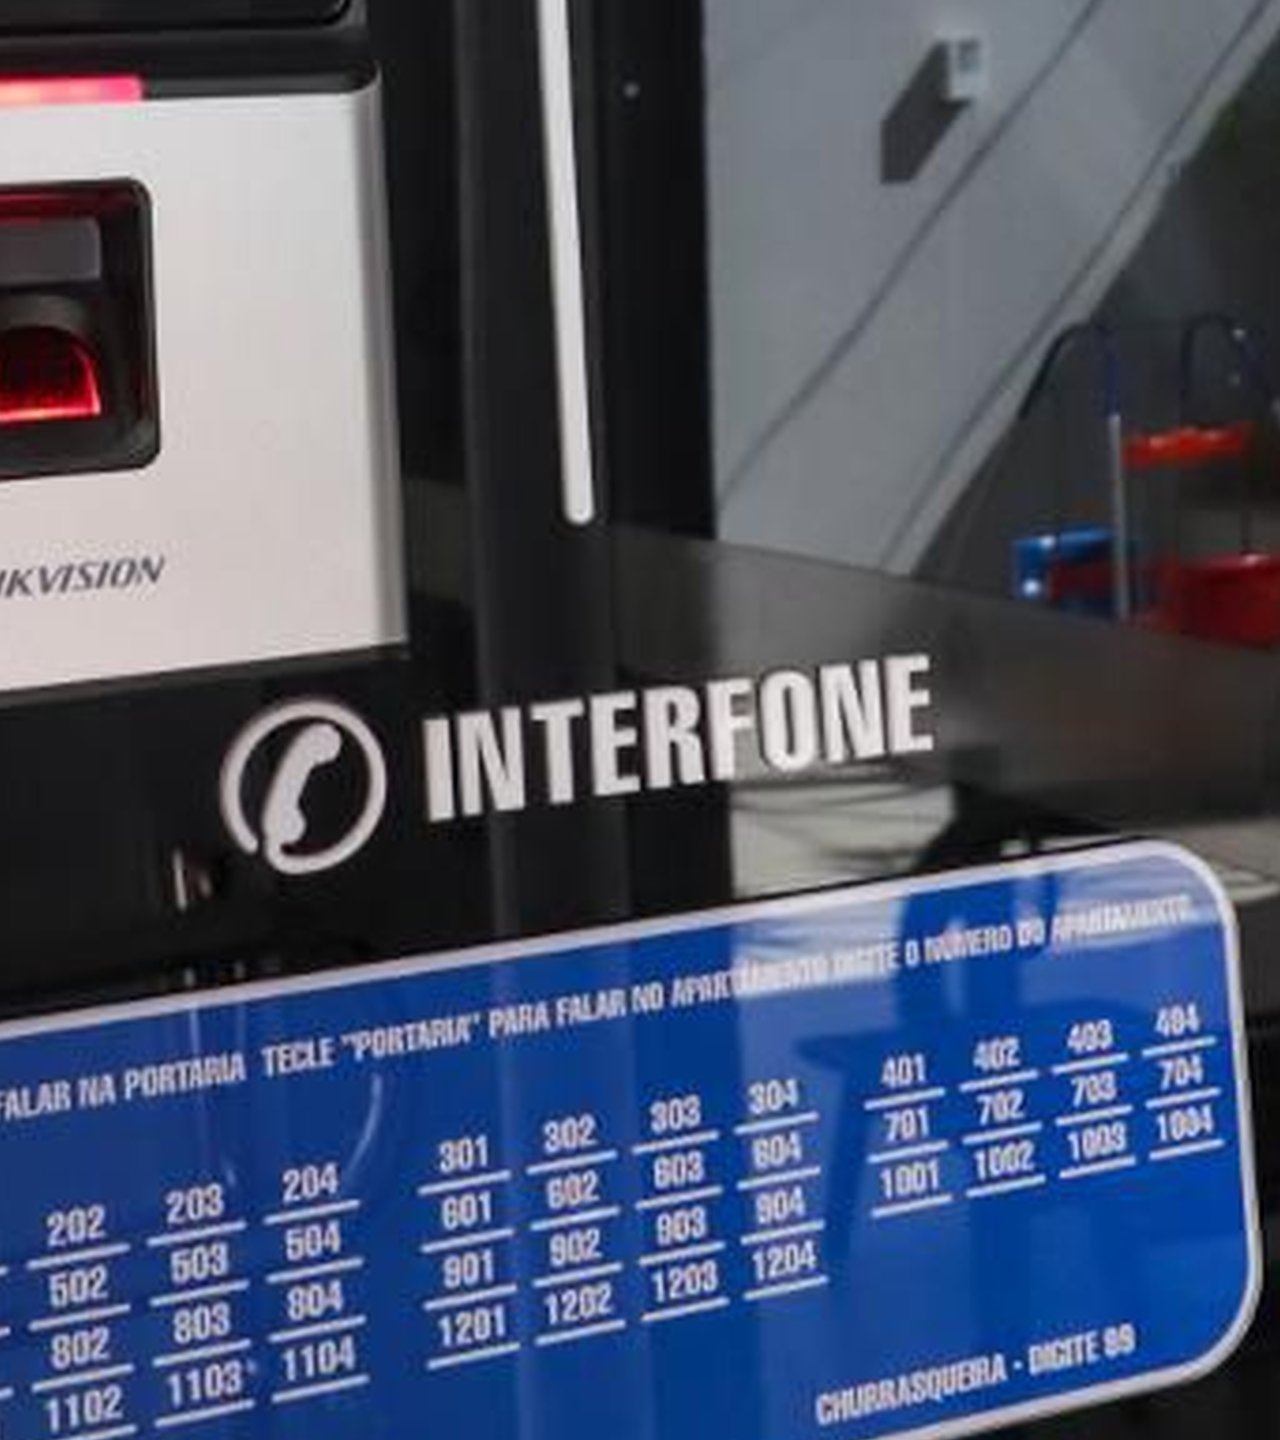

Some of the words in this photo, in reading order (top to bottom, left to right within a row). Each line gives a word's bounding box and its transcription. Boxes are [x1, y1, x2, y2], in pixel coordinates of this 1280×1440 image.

[422, 654, 933, 822] INTERFONE
[79, 1074, 116, 1106] NA
[124, 1054, 246, 1099] PORTARIA
[263, 1040, 335, 1077] TECLE
[489, 1000, 551, 1037] PARA
[557, 988, 626, 1026] FALAR
[633, 981, 663, 1012] NO
[881, 1055, 926, 1089] 401
[974, 1037, 1019, 1071] 402
[1067, 1020, 1113, 1053] 403
[1156, 1004, 1200, 1037] 404
[439, 1136, 488, 1173] 301
[544, 1118, 596, 1154] 302
[651, 1096, 701, 1133] 303
[749, 1079, 799, 1114] 304
[886, 1108, 929, 1142] 701
[977, 1090, 1023, 1124] 702
[1072, 1073, 1116, 1106] 703
[1158, 1055, 1204, 1088] 704
[442, 1192, 492, 1230] 601
[547, 1175, 599, 1211] 602
[654, 1154, 704, 1189] 603
[752, 1134, 802, 1169] 604
[880, 1161, 940, 1199] 1001
[974, 1142, 1033, 1180] 1002
[1068, 1122, 1127, 1159] 1003
[1155, 1106, 1214, 1143] 1004
[47, 1208, 105, 1247] 202
[167, 1185, 224, 1222] 203
[283, 1163, 339, 1201] 204
[444, 1251, 495, 1289] 901
[550, 1230, 601, 1267] 902
[656, 1210, 706, 1247] 903
[756, 1188, 805, 1223] 904
[49, 1269, 108, 1307] 502
[170, 1244, 228, 1281] 503
[285, 1222, 341, 1259] 504
[438, 1310, 507, 1349] 1201
[545, 1287, 613, 1326] 1202
[651, 1264, 717, 1303] 1203
[751, 1242, 815, 1282] 1204
[51, 1329, 110, 1368] 802
[173, 1304, 231, 1342] 803
[288, 1280, 343, 1317] 804
[46, 1389, 121, 1433] 1102
[168, 1362, 243, 1405] 1103
[282, 1338, 357, 1381] 1104
[816, 1353, 1008, 1425] CHURRASQUEIRA
[1028, 1329, 1100, 1375] DIGITE
